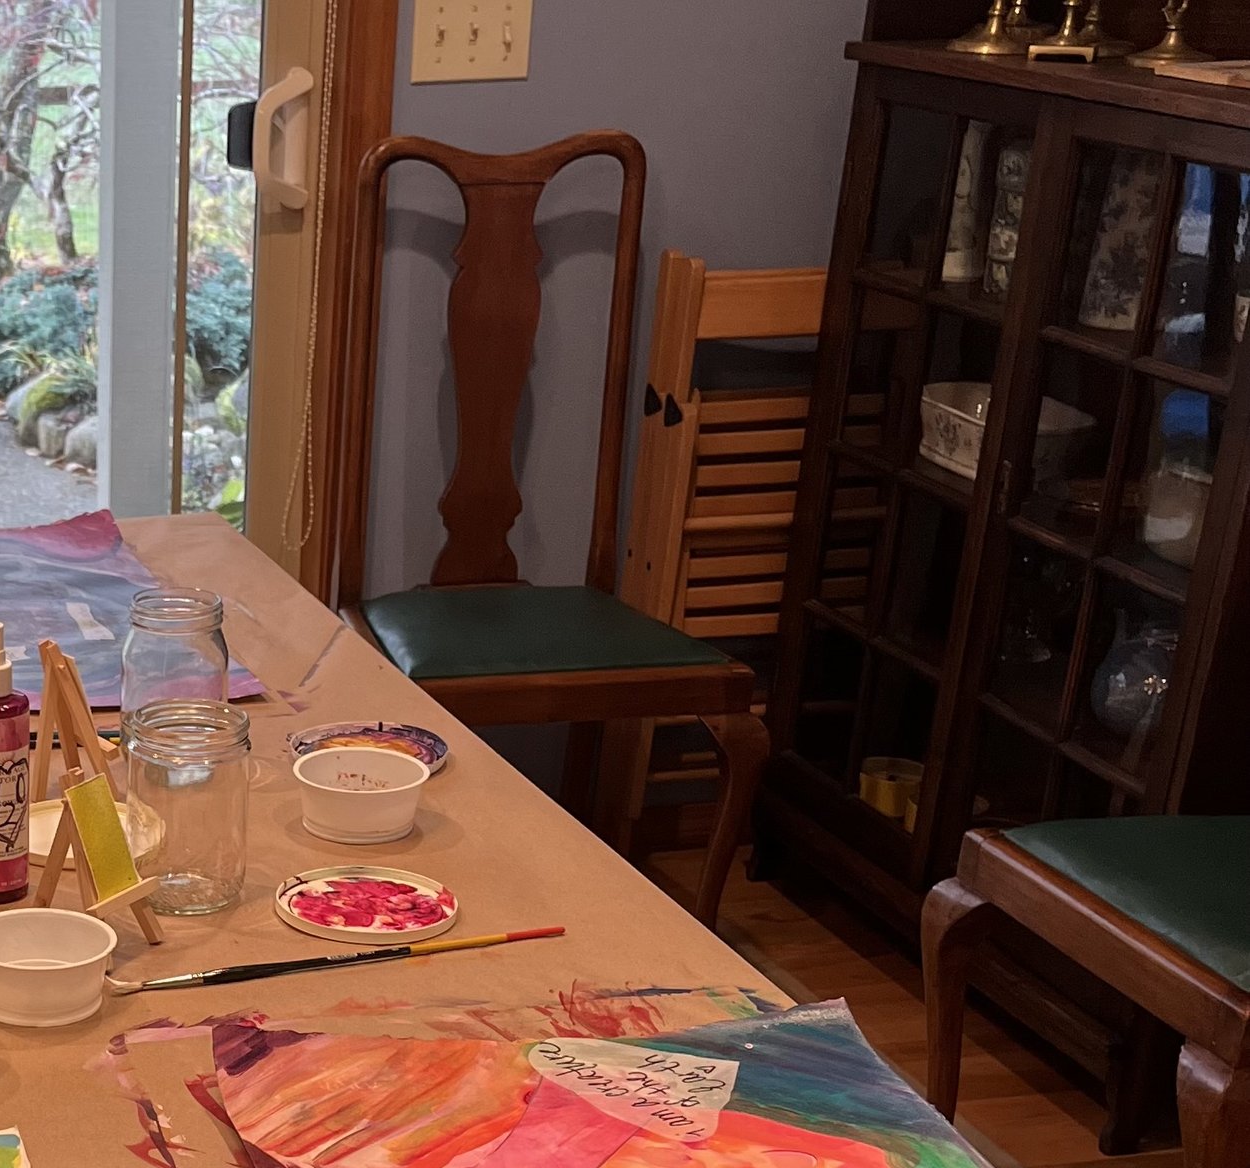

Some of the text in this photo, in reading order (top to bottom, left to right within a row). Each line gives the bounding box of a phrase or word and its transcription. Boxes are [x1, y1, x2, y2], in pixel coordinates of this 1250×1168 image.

[538, 1041, 629, 1097] creature
[627, 1071, 700, 1108] of the
[631, 1097, 660, 1107] a
[651, 1108, 694, 1127] am
